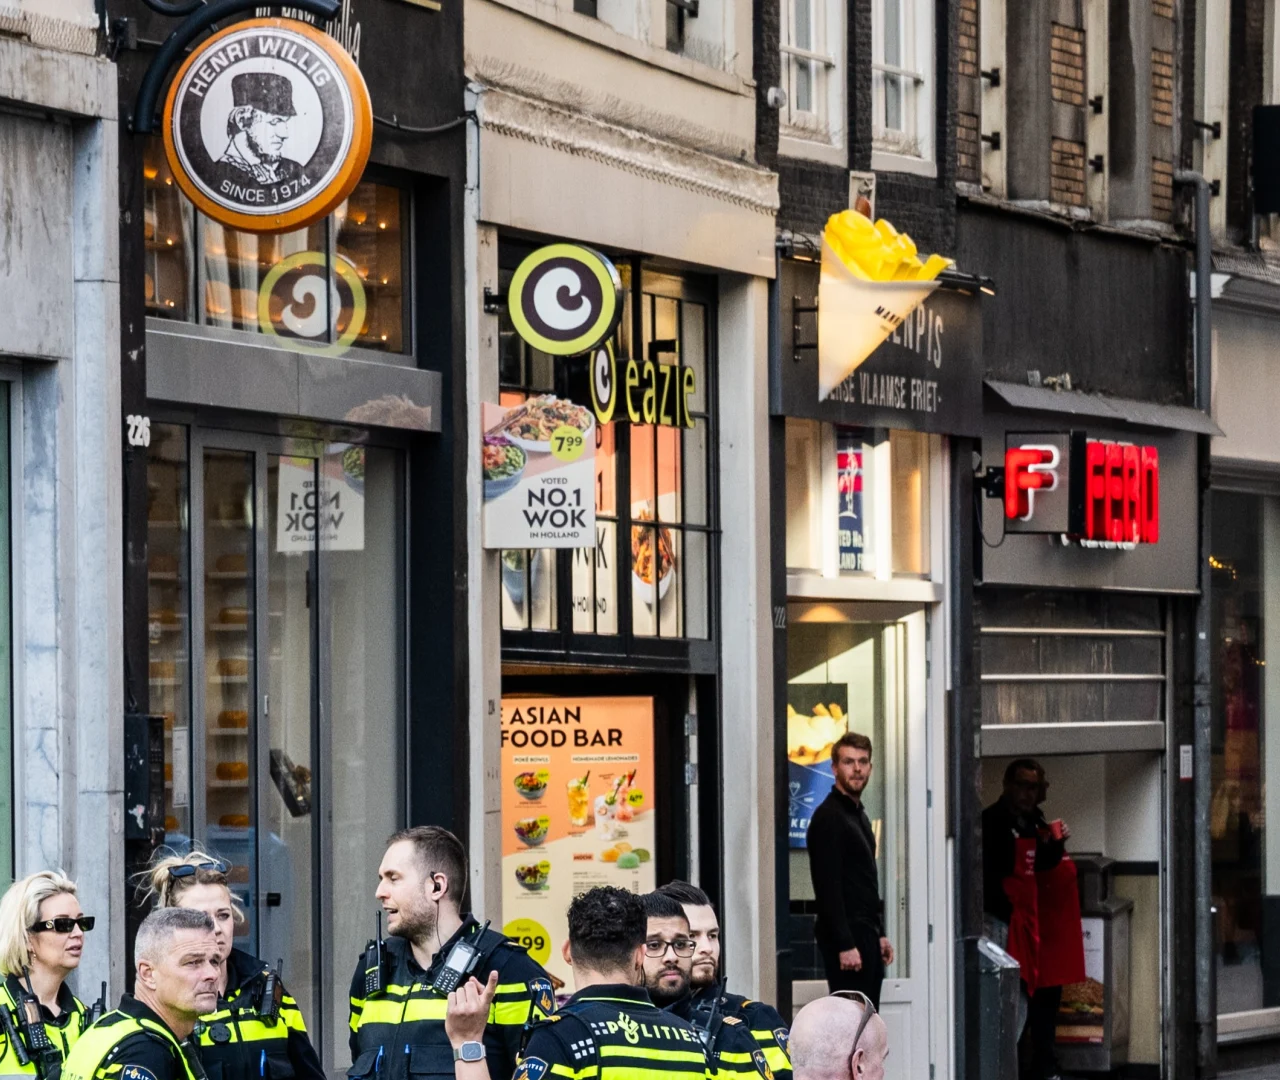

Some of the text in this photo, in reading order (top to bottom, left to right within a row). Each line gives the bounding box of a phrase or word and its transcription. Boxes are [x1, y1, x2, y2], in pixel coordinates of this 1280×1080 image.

[189, 35, 332, 98] HENRI WILLIG
[219, 174, 312, 203] SINCE 1974
[625, 341, 696, 429] eazie
[859, 372, 906, 408] VLAAMSE
[126, 414, 151, 447] 226
[555, 437, 583, 452] 7.99
[528, 488, 581, 507] NO.1
[522, 509, 586, 528] WOK
[530, 531, 580, 539] IN HOLLAND
[510, 706, 581, 725] ASIAN
[501, 728, 623, 748] FOOD BAR
[608, 1012, 691, 1044] POLITIE
